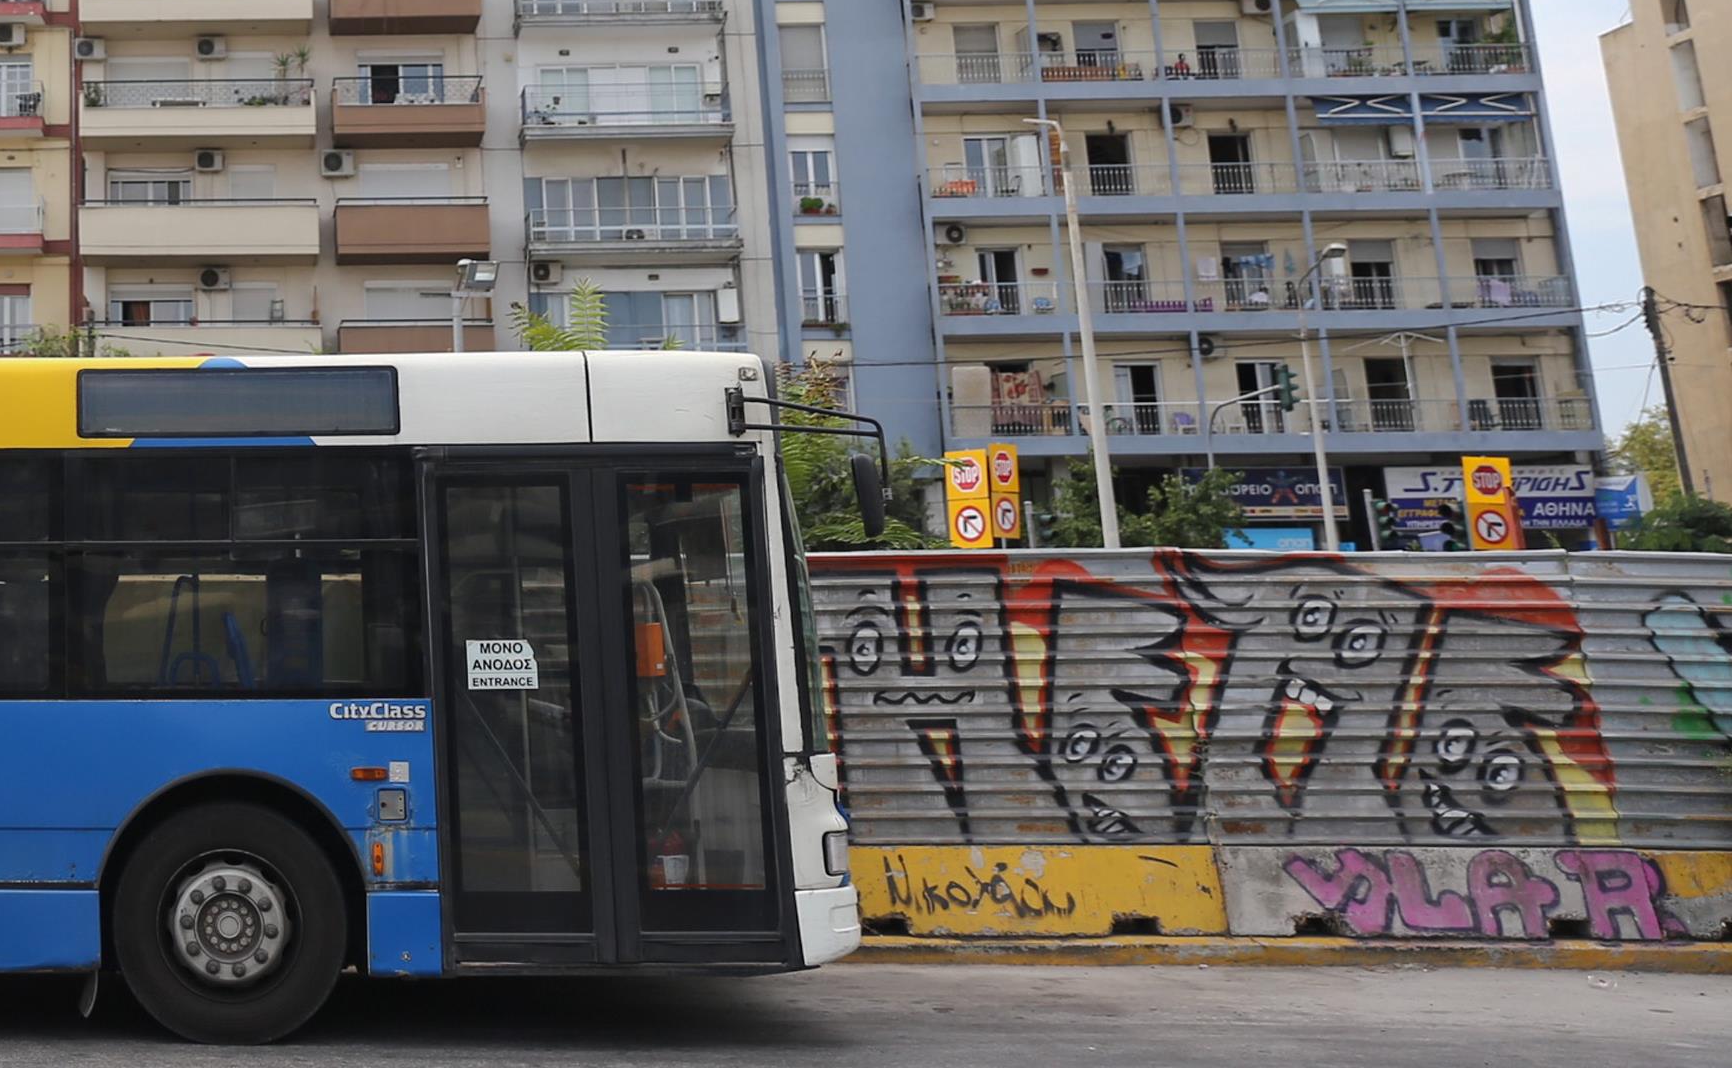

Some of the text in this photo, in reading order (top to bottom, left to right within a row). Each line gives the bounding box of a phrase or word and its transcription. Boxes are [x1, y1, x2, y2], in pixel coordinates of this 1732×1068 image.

[953, 466, 979, 483] STOP
[1473, 472, 1501, 489] STOP
[1532, 502, 1596, 517] ΑΘΗΝΑ
[479, 642, 524, 654] ΜΟΝΟ
[472, 658, 533, 671] ΑΝΟΔΟΣ
[472, 676, 534, 688] ENTRANCE
[329, 702, 427, 720] CityClass
[366, 720, 425, 732] CURSOR
